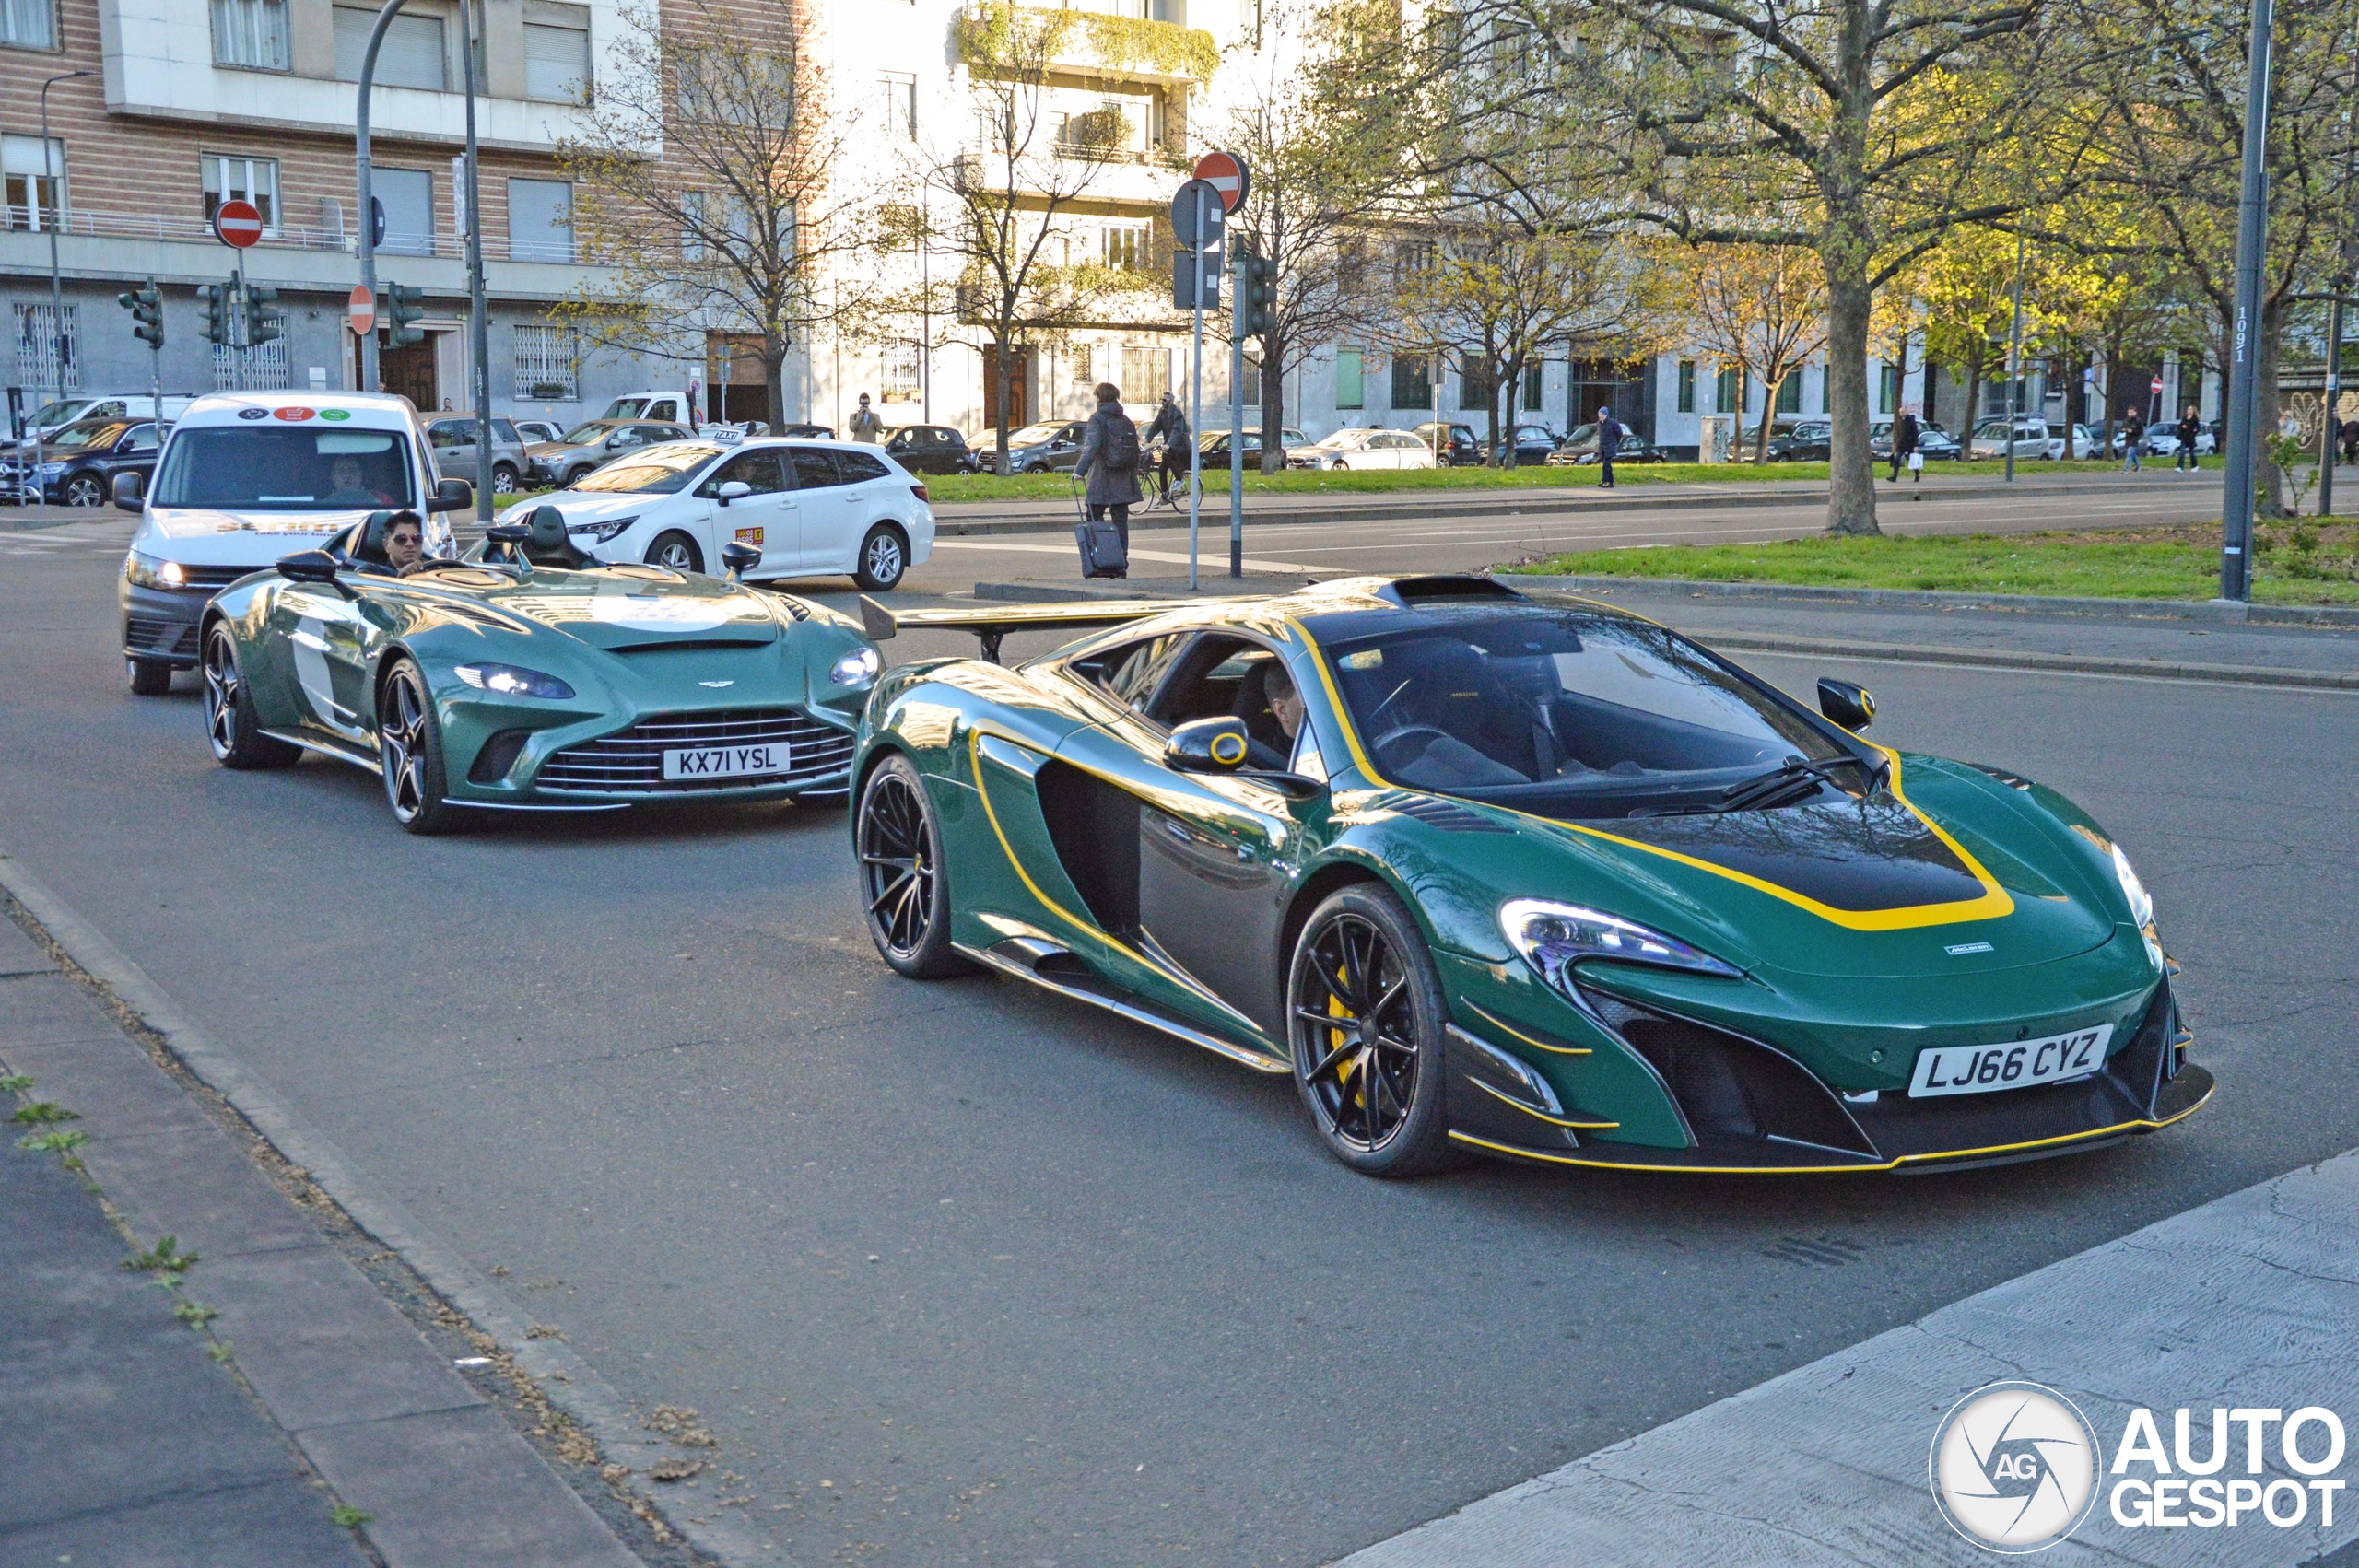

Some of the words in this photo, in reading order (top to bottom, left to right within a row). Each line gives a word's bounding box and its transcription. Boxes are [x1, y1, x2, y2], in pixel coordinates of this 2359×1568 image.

[2236, 306, 2247, 362] 109/1
[716, 430, 737, 439] TAXI
[680, 750, 731, 774] KX71
[737, 747, 777, 770] YSL
[1951, 944, 1989, 953] McLaren
[1925, 1047, 2027, 1089] LJ66
[2032, 1032, 2099, 1077] CYZ
